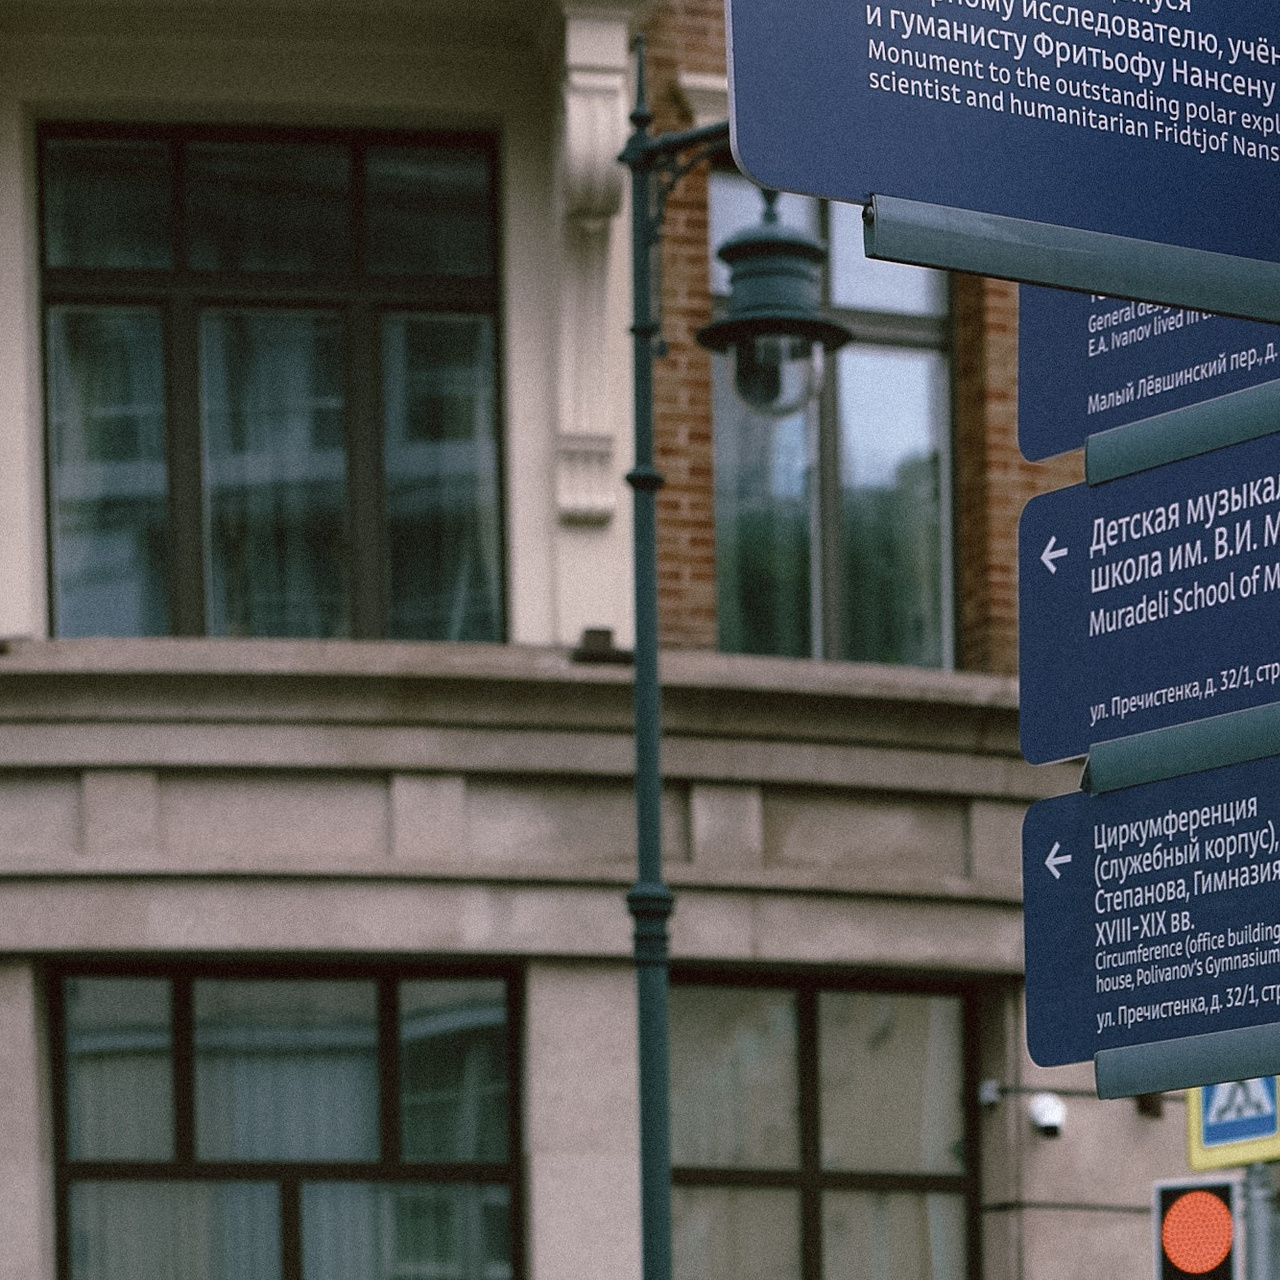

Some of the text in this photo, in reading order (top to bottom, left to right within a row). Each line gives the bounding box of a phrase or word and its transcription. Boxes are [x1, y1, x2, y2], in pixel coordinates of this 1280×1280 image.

[866, 4, 881, 27] и
[890, 9, 1027, 60] гуманисту
[1033, 32, 1165, 86] Фритьофу
[1172, 58, 1276, 107] Нансену
[1022, 0, 1223, 60] исследователю,
[868, 39, 984, 79] Monument
[990, 62, 1011, 84] to
[1016, 66, 1051, 91] the
[1056, 78, 1179, 121] outstanding
[1186, 101, 1236, 125] polar
[869, 71, 961, 104] scientist
[966, 90, 1004, 112] and
[1010, 92, 1148, 138] humanitarian
[1154, 121, 1228, 154] Fridtjof
[1088, 301, 1135, 333] General
[1088, 336, 1109, 357] E.A.
[1111, 323, 1151, 350] Ivanov
[1153, 309, 1183, 335] lived
[1087, 382, 1134, 415] Малый
[1136, 352, 1226, 400] Лёвшинский
[1230, 348, 1263, 371] пер.,
[1265, 342, 1278, 364] д.
[1089, 502, 1179, 559] Детская
[1091, 550, 1162, 594] школа
[1169, 539, 1208, 572] им.
[1215, 519, 1258, 560] В.И.
[1089, 591, 1168, 637] Muradeli
[1173, 572, 1235, 615] School
[1239, 564, 1260, 598] of
[1090, 702, 1109, 727] ул.
[1111, 681, 1202, 720] Пречистенка,
[1204, 678, 1217, 699] д.
[1220, 665, 1254, 691] 32/1,
[1094, 796, 1257, 854] Циркумференция
[1095, 836, 1199, 888] (служебный
[1204, 820, 1278, 863] корпус),
[1095, 878, 1190, 914] Степанова,
[1171, 911, 1195, 933] вв.
[1095, 941, 1182, 970] Circumference
[1185, 931, 1225, 958] (office
[1096, 974, 1135, 993] house,
[1096, 1011, 1116, 1034] ул.
[1118, 997, 1209, 1029] Пречистенка,
[1210, 994, 1223, 1015] д.
[1225, 983, 1259, 1008] 32/1,
